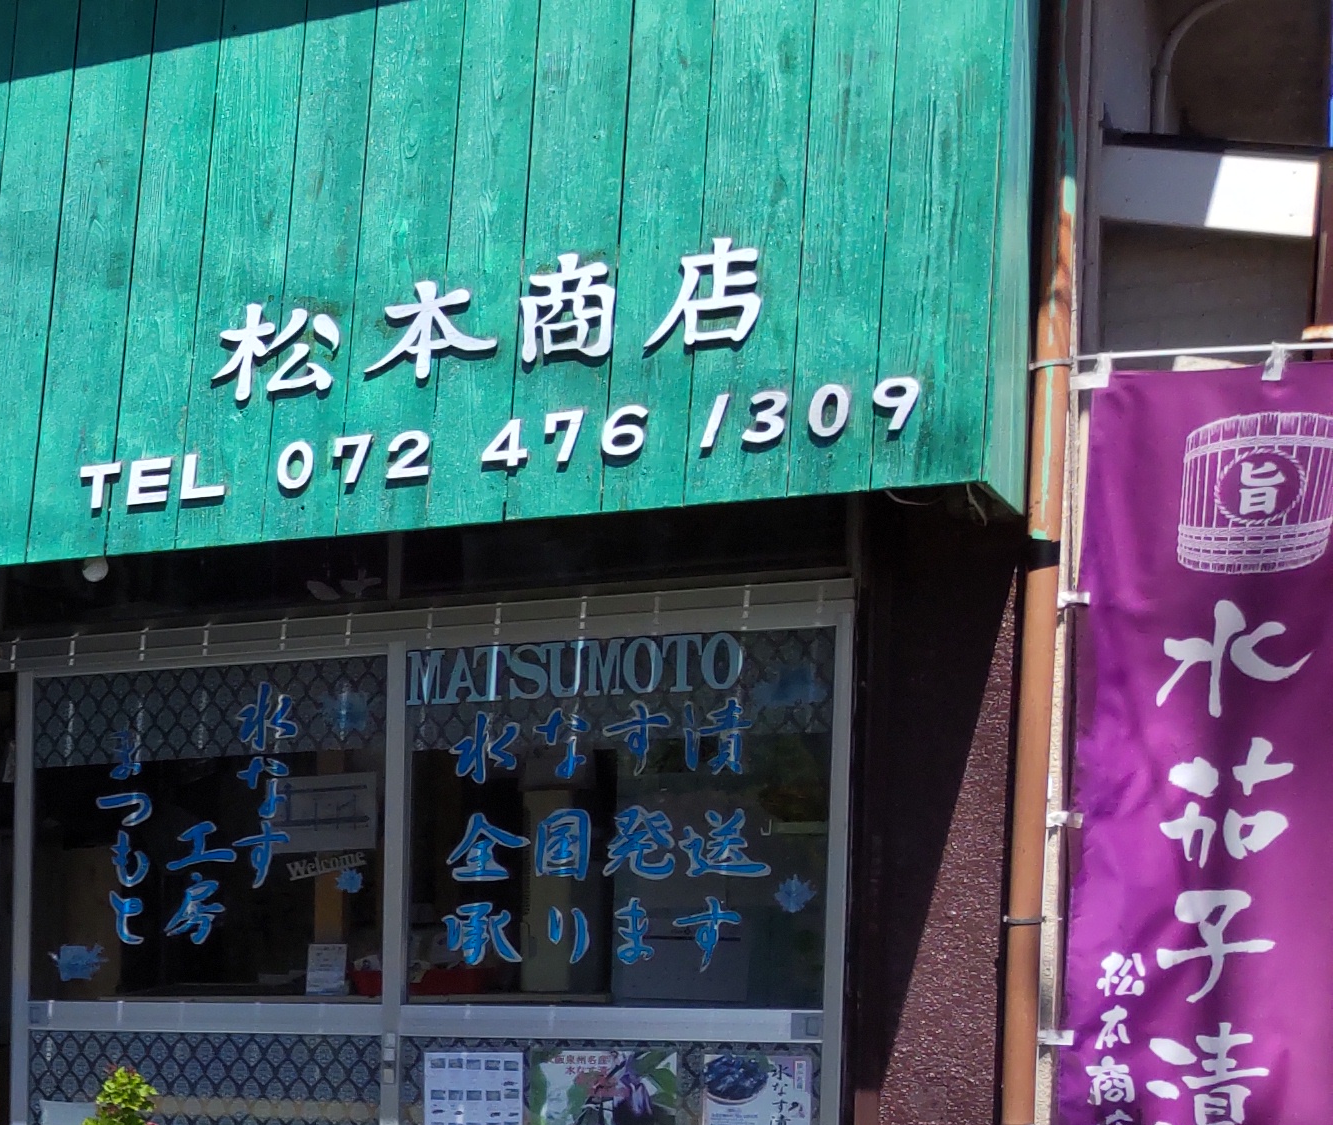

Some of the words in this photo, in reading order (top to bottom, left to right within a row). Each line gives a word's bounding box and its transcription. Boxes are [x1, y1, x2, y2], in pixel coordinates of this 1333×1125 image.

[210, 236, 763, 401] 松本商店
[79, 452, 226, 510] TEL
[276, 429, 431, 491] 072
[481, 404, 649, 469] 476
[699, 376, 922, 451] 1309
[1237, 460, 1279, 518] 旨
[406, 632, 744, 706] MATSUMOTO
[449, 697, 754, 784] 水なす漬
[232, 681, 297, 888] 水なす
[96, 728, 153, 944] まつもと
[286, 850, 368, 881] Welcome
[446, 804, 772, 882] 全国発送
[164, 820, 237, 944] 工房
[441, 895, 743, 972] 承ります
